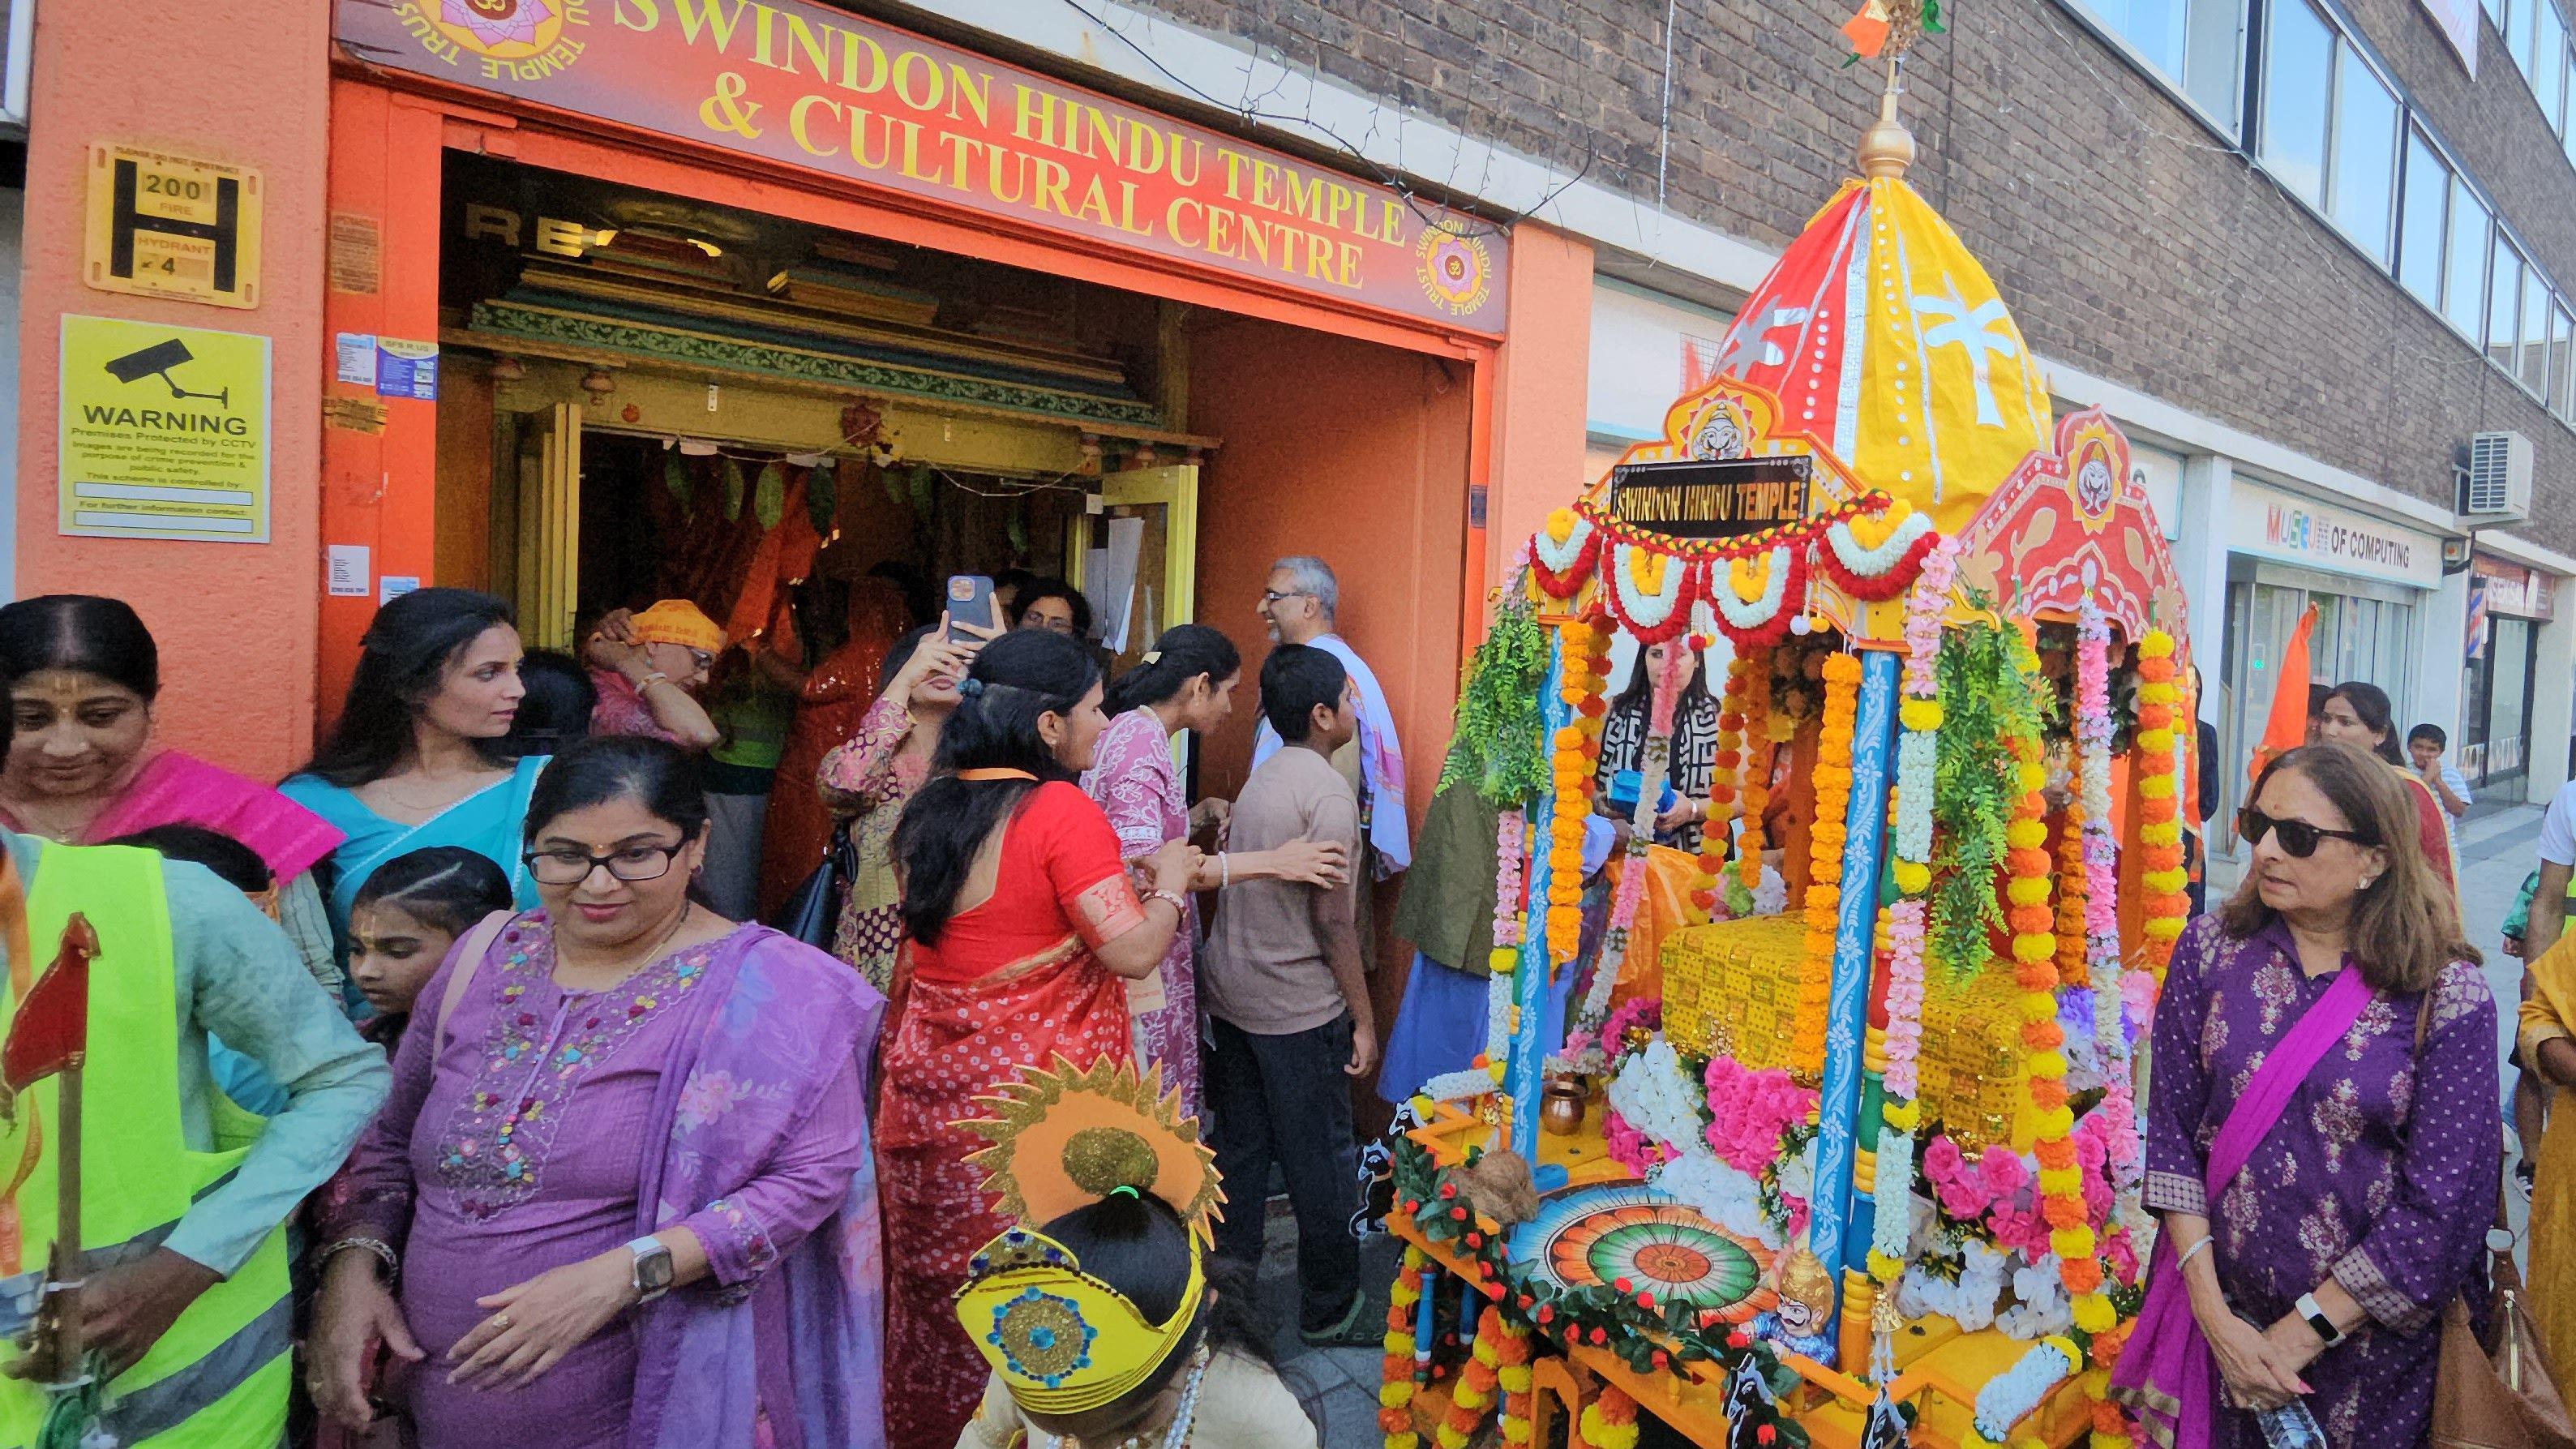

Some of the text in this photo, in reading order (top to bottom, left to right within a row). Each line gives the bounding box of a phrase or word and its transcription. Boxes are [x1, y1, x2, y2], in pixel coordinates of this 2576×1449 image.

[390, 0, 586, 81] TEMPLE TRUS
[614, 0, 1406, 248] SWINDON HINDU TEMPLE
[146, 174, 201, 200] 200
[699, 72, 1364, 290] & CULTURAL CENTRE
[160, 202, 194, 216] FIRE
[138, 237, 212, 255] HYDRANT
[161, 257, 176, 276] 4
[1416, 266, 1444, 310] TRUST
[1451, 287, 1490, 316] TEMPLE
[83, 405, 247, 435] WARNING
[71, 427, 256, 448] Premises Protected by CCTV
[72, 441, 113, 451] Images
[136, 446, 166, 456] being
[169, 448, 218, 458] recorded
[82, 452, 127, 461] purpose
[144, 456, 175, 464] crime
[178, 458, 235, 468] prevention
[112, 474, 155, 484] scheme
[170, 478, 225, 488] controlled
[129, 465, 162, 474] public
[79, 501, 98, 509] For
[101, 502, 138, 511] further
[141, 504, 203, 514] information
[1684, 484, 1732, 521] HINDU
[1737, 482, 1801, 521] TEMPLE
[2331, 525, 2347, 555] OF
[2350, 530, 2409, 568] COMPUTING
